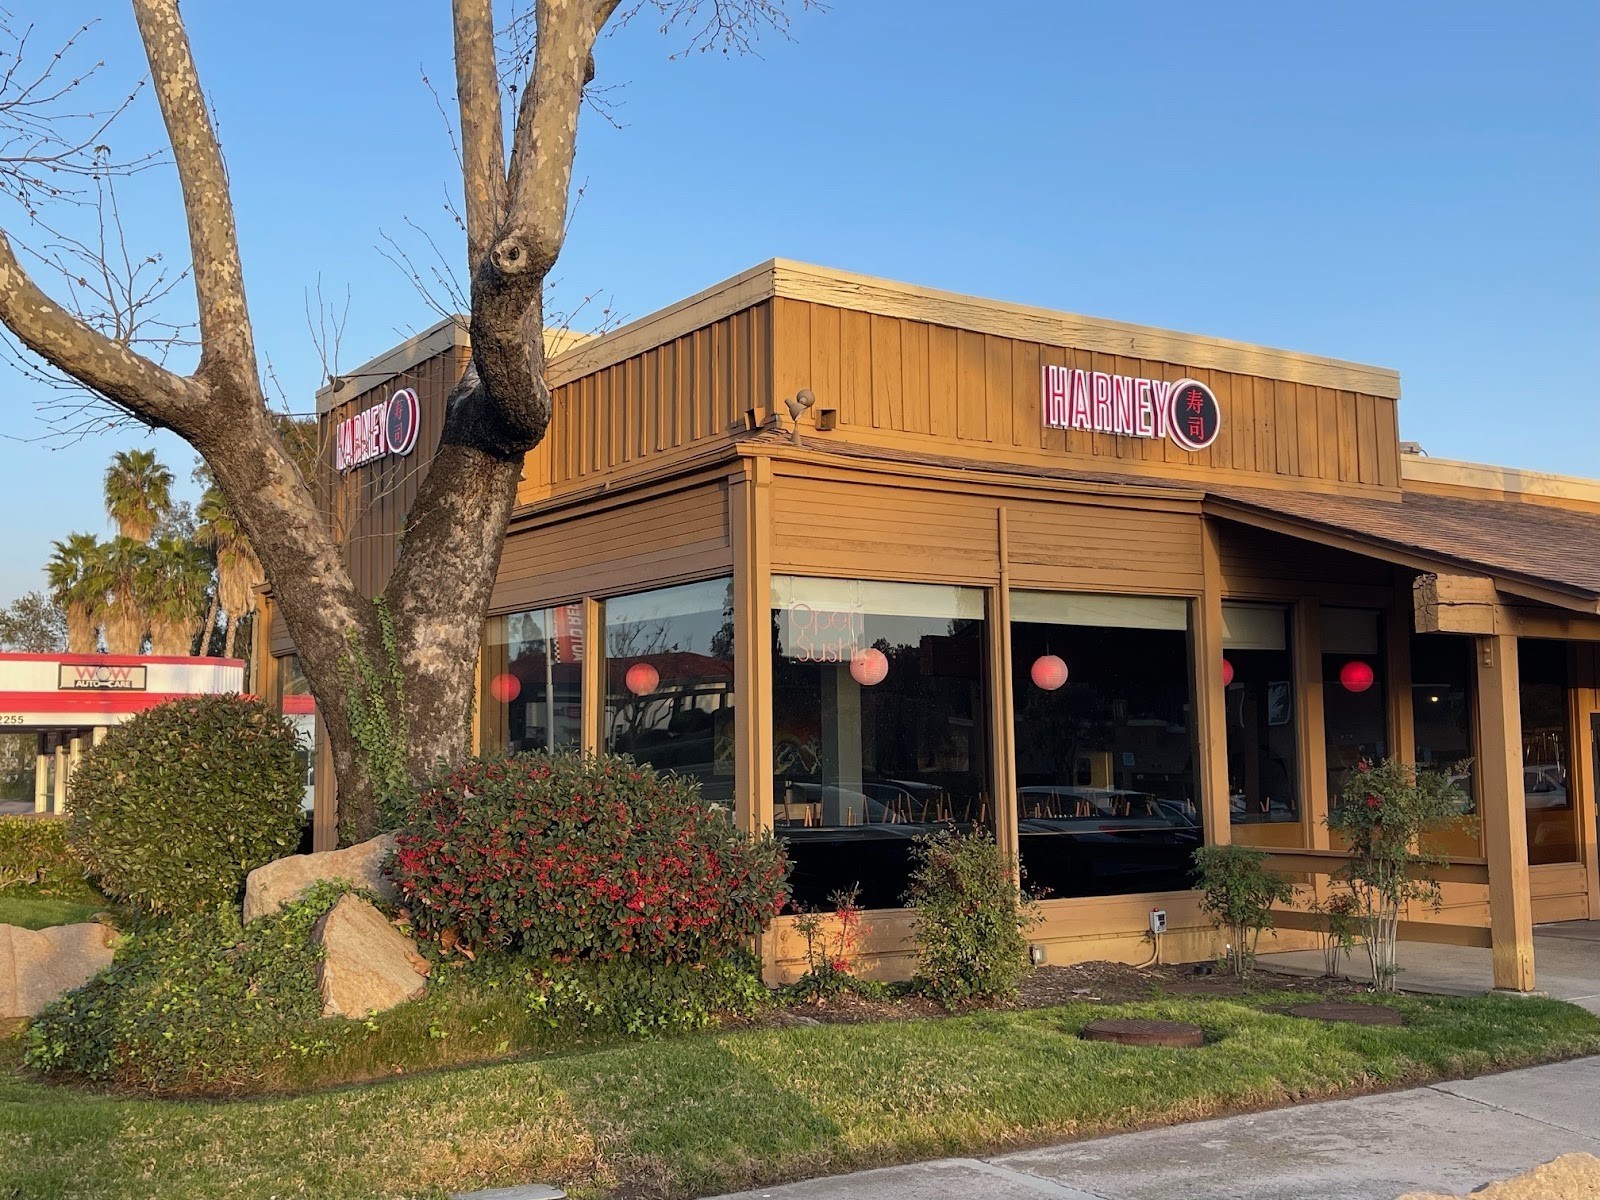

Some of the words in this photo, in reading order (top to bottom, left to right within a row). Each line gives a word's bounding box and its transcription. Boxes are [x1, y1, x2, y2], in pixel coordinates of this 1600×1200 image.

[1042, 364, 1170, 439] HARNEY
[1186, 389, 1203, 441] 寿司
[335, 400, 388, 471] HARNEY
[790, 603, 864, 635] Open
[796, 632, 859, 663] Sushi
[75, 666, 132, 681] WOW
[75, 680, 100, 688] AUTO
